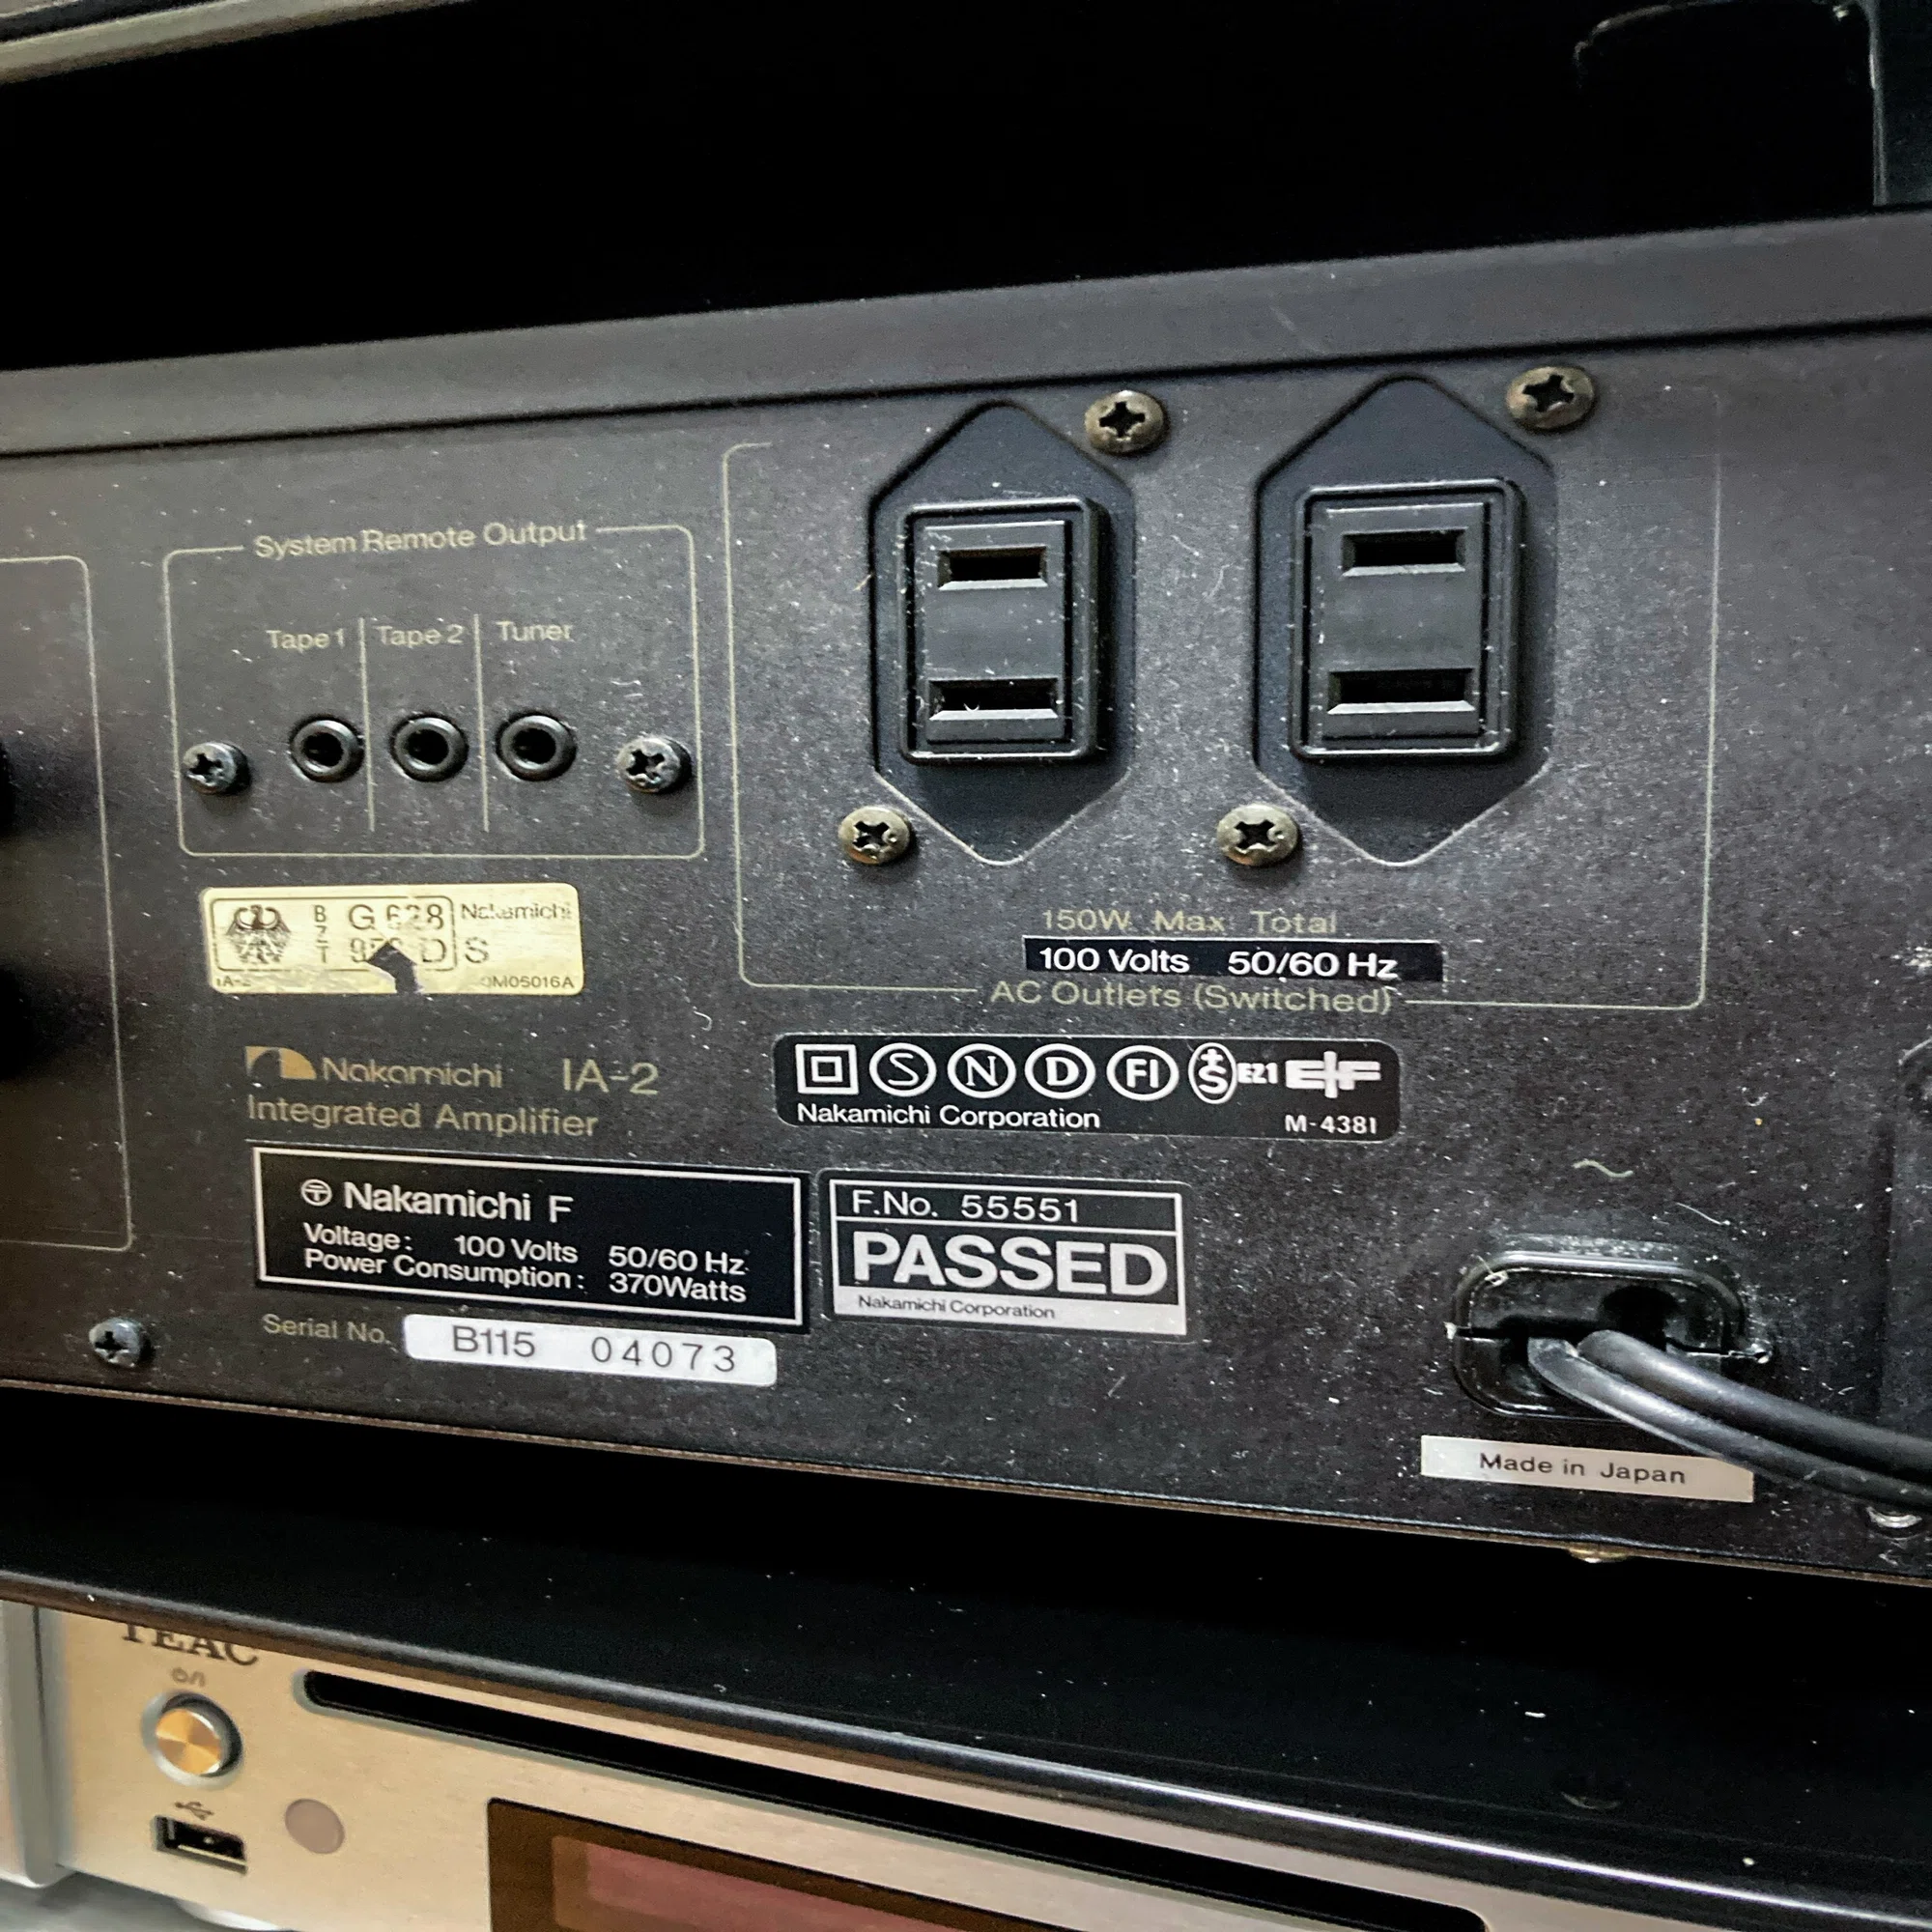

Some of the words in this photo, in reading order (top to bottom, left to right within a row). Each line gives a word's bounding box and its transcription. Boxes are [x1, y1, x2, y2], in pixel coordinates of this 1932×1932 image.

[254, 535, 357, 561] System
[362, 528, 476, 553] Remote
[483, 521, 587, 548] Output
[266, 630, 332, 650] Tape
[336, 630, 345, 647] 1
[378, 626, 442, 646] Tape
[446, 625, 465, 643] 2
[497, 620, 573, 642] Tuner
[1043, 909, 1130, 931] 150W
[1153, 910, 1227, 933] Max
[1251, 911, 1337, 934] Total
[1039, 947, 1100, 971] 100
[1108, 948, 1190, 974] Volts
[1228, 952, 1340, 978] 50/60
[1349, 952, 1399, 980] Hz
[990, 980, 1042, 1005] AC
[1051, 980, 1182, 1008] Outlets
[1193, 984, 1393, 1015] (Switched)
[322, 1057, 502, 1089] Nakamichi
[562, 1057, 659, 1095] IA-2
[247, 1094, 422, 1130] Integrated
[435, 1108, 599, 1137] Amplifier
[797, 1104, 931, 1126] Nakamichi
[939, 1106, 1101, 1132] Corporation
[1285, 1115, 1378, 1134] M-4381
[344, 1181, 531, 1221] Nakamichi
[548, 1195, 574, 1223] F
[852, 1189, 939, 1218] F.No.
[960, 1194, 1078, 1223] 55551
[454, 1235, 504, 1258] 100
[510, 1237, 578, 1264] Volts
[609, 1245, 697, 1271] 50/60
[705, 1252, 745, 1275] Hz
[852, 1231, 1169, 1297] PASSED
[304, 1248, 384, 1275] Power
[609, 1272, 747, 1303] 370Watts
[858, 1294, 947, 1314] Nakamichi
[950, 1301, 1055, 1320] Corporation
[263, 1315, 338, 1340] Serial
[351, 1323, 390, 1344] No.
[452, 1325, 536, 1358] B115
[592, 1336, 735, 1372] 04073
[1479, 1452, 1552, 1474] Made
[1563, 1459, 1585, 1477] in
[1600, 1462, 1686, 1485] Japan
